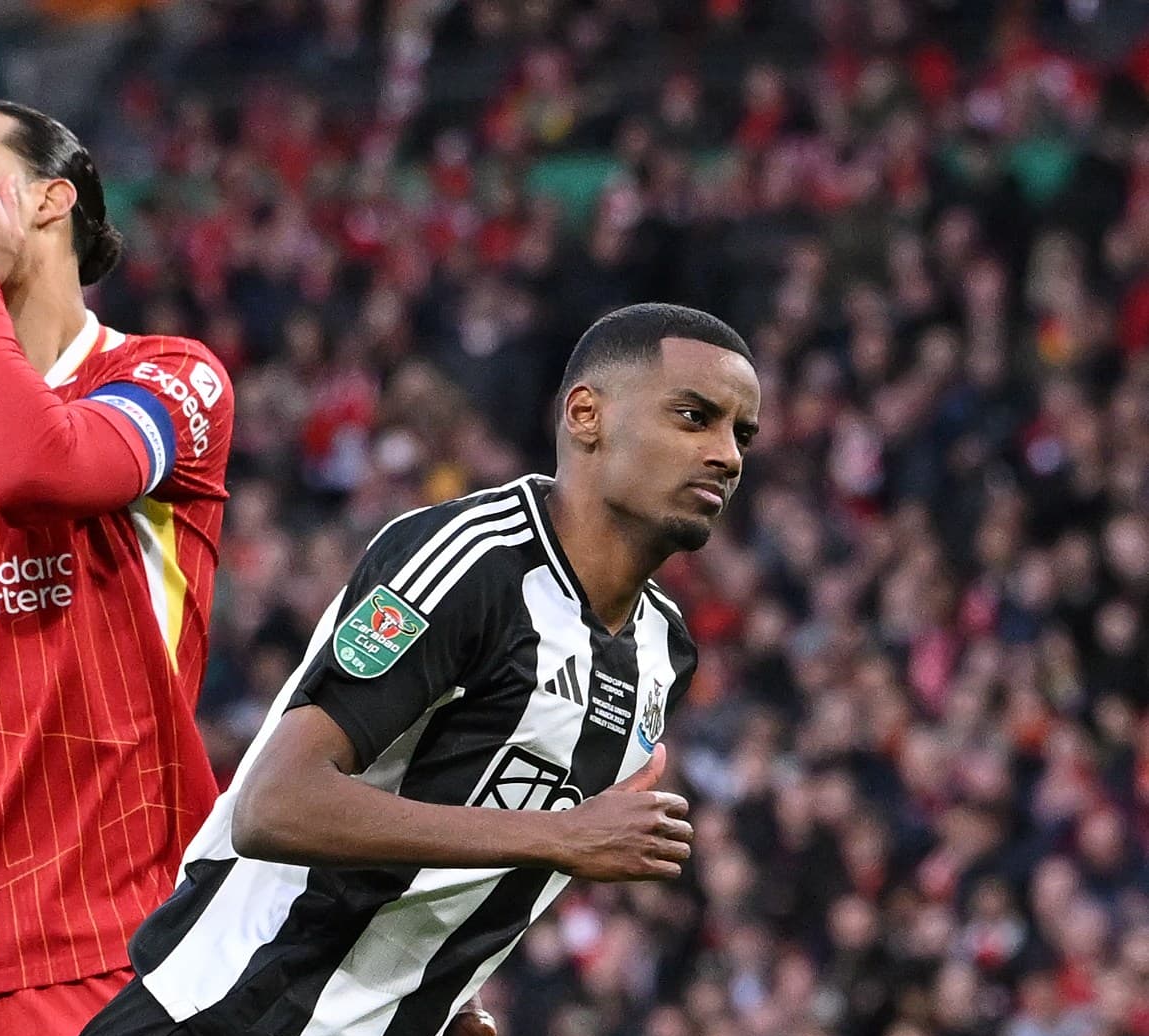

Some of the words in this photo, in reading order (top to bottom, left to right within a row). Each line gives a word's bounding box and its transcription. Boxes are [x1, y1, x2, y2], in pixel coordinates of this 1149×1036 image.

[132, 361, 210, 458] Expedia
[349, 618, 401, 653] Carabao
[354, 634, 380, 654] Cup
